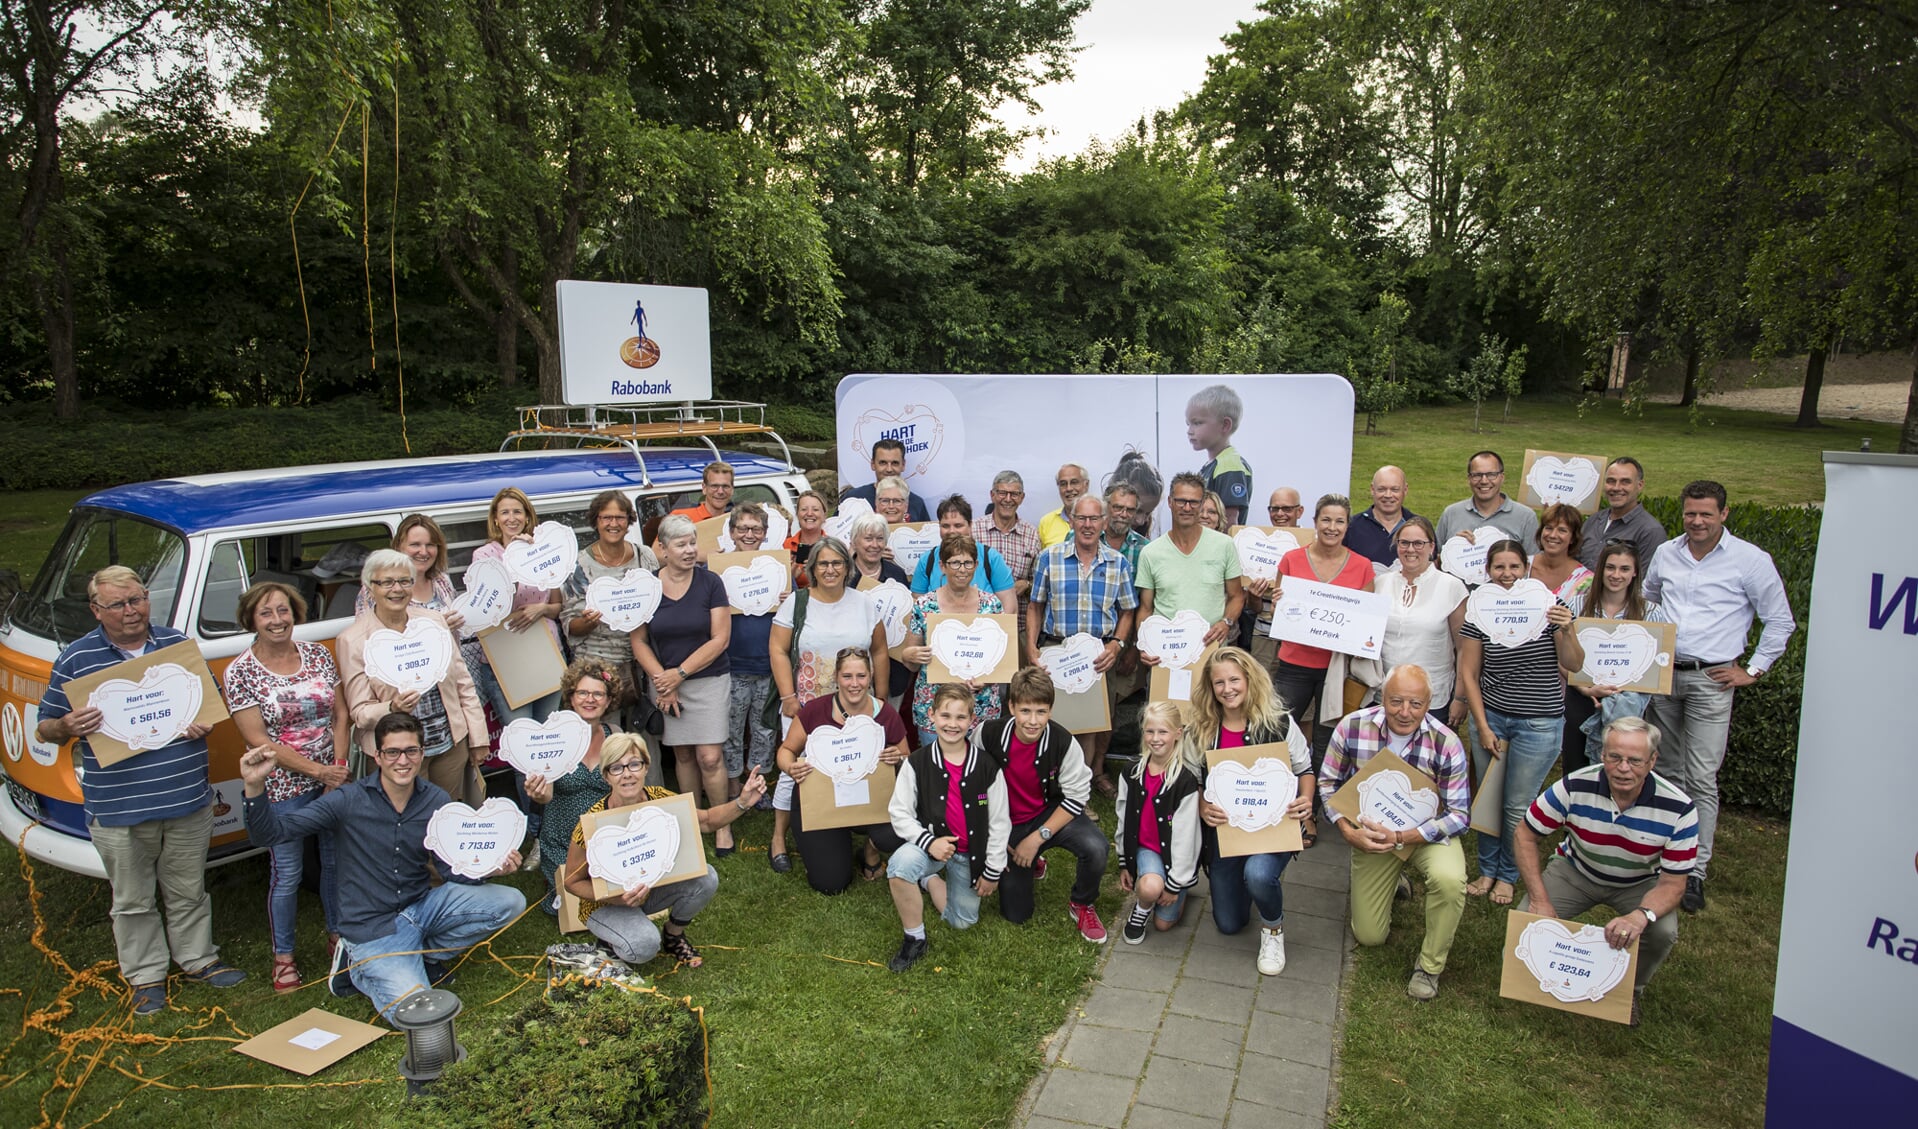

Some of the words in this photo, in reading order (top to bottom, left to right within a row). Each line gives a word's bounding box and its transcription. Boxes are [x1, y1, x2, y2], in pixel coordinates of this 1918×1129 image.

[611, 380, 672, 395] Rabobank
[881, 424, 916, 440] HART
[527, 548, 538, 557] Hart
[470, 596, 478, 607] Hart
[1868, 572, 1918, 635] W
[1502, 616, 1528, 624] 770,93
[1310, 627, 1322, 636] Het
[405, 658, 430, 670] 309,37
[126, 694, 142, 704] Hart
[145, 690, 164, 699] voor:
[130, 716, 136, 725] €
[140, 708, 171, 723] 561,56
[538, 750, 563, 759] 537,77
[841, 752, 861, 762] 361,71
[1242, 798, 1268, 806] 918,44
[1392, 792, 1404, 802] Hart
[468, 842, 495, 850] 713,83
[617, 839, 630, 847] Hart
[632, 833, 648, 842] voor:
[622, 860, 627, 868] €
[630, 850, 655, 865] 337,92
[1866, 916, 1918, 965] Ra
[1555, 942, 1571, 951] Hart
[1573, 947, 1592, 956] voor:
[1558, 963, 1591, 978] 323,64
